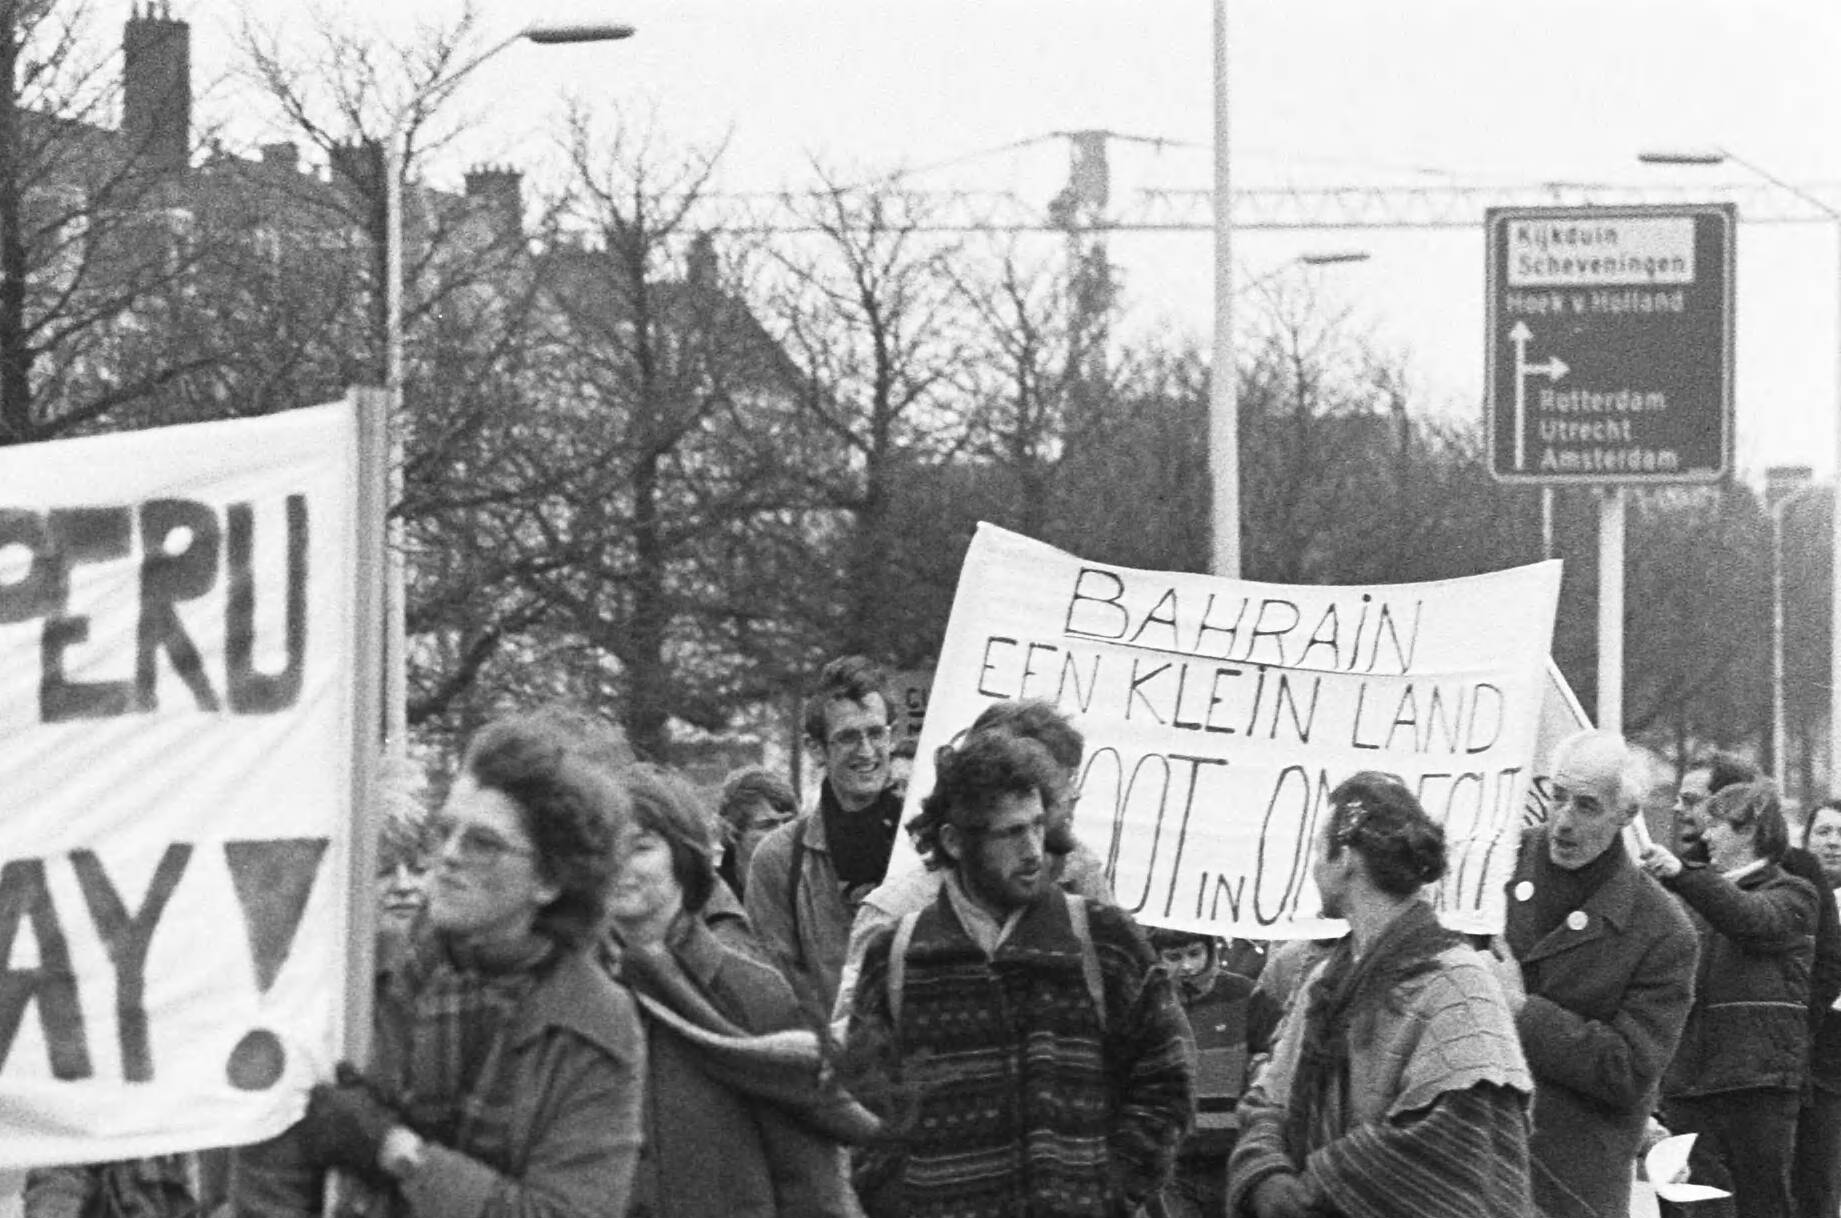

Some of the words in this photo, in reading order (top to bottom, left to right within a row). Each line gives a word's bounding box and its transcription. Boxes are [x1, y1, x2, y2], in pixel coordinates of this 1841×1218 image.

[1539, 389, 1666, 412] Rotterdam
[1540, 418, 1631, 442] Utrecht
[1540, 447, 1679, 471] Amsterdam
[977, 636, 1101, 713] EEN
[1351, 681, 1504, 754] LAND
[1197, 872, 1245, 922] IN
